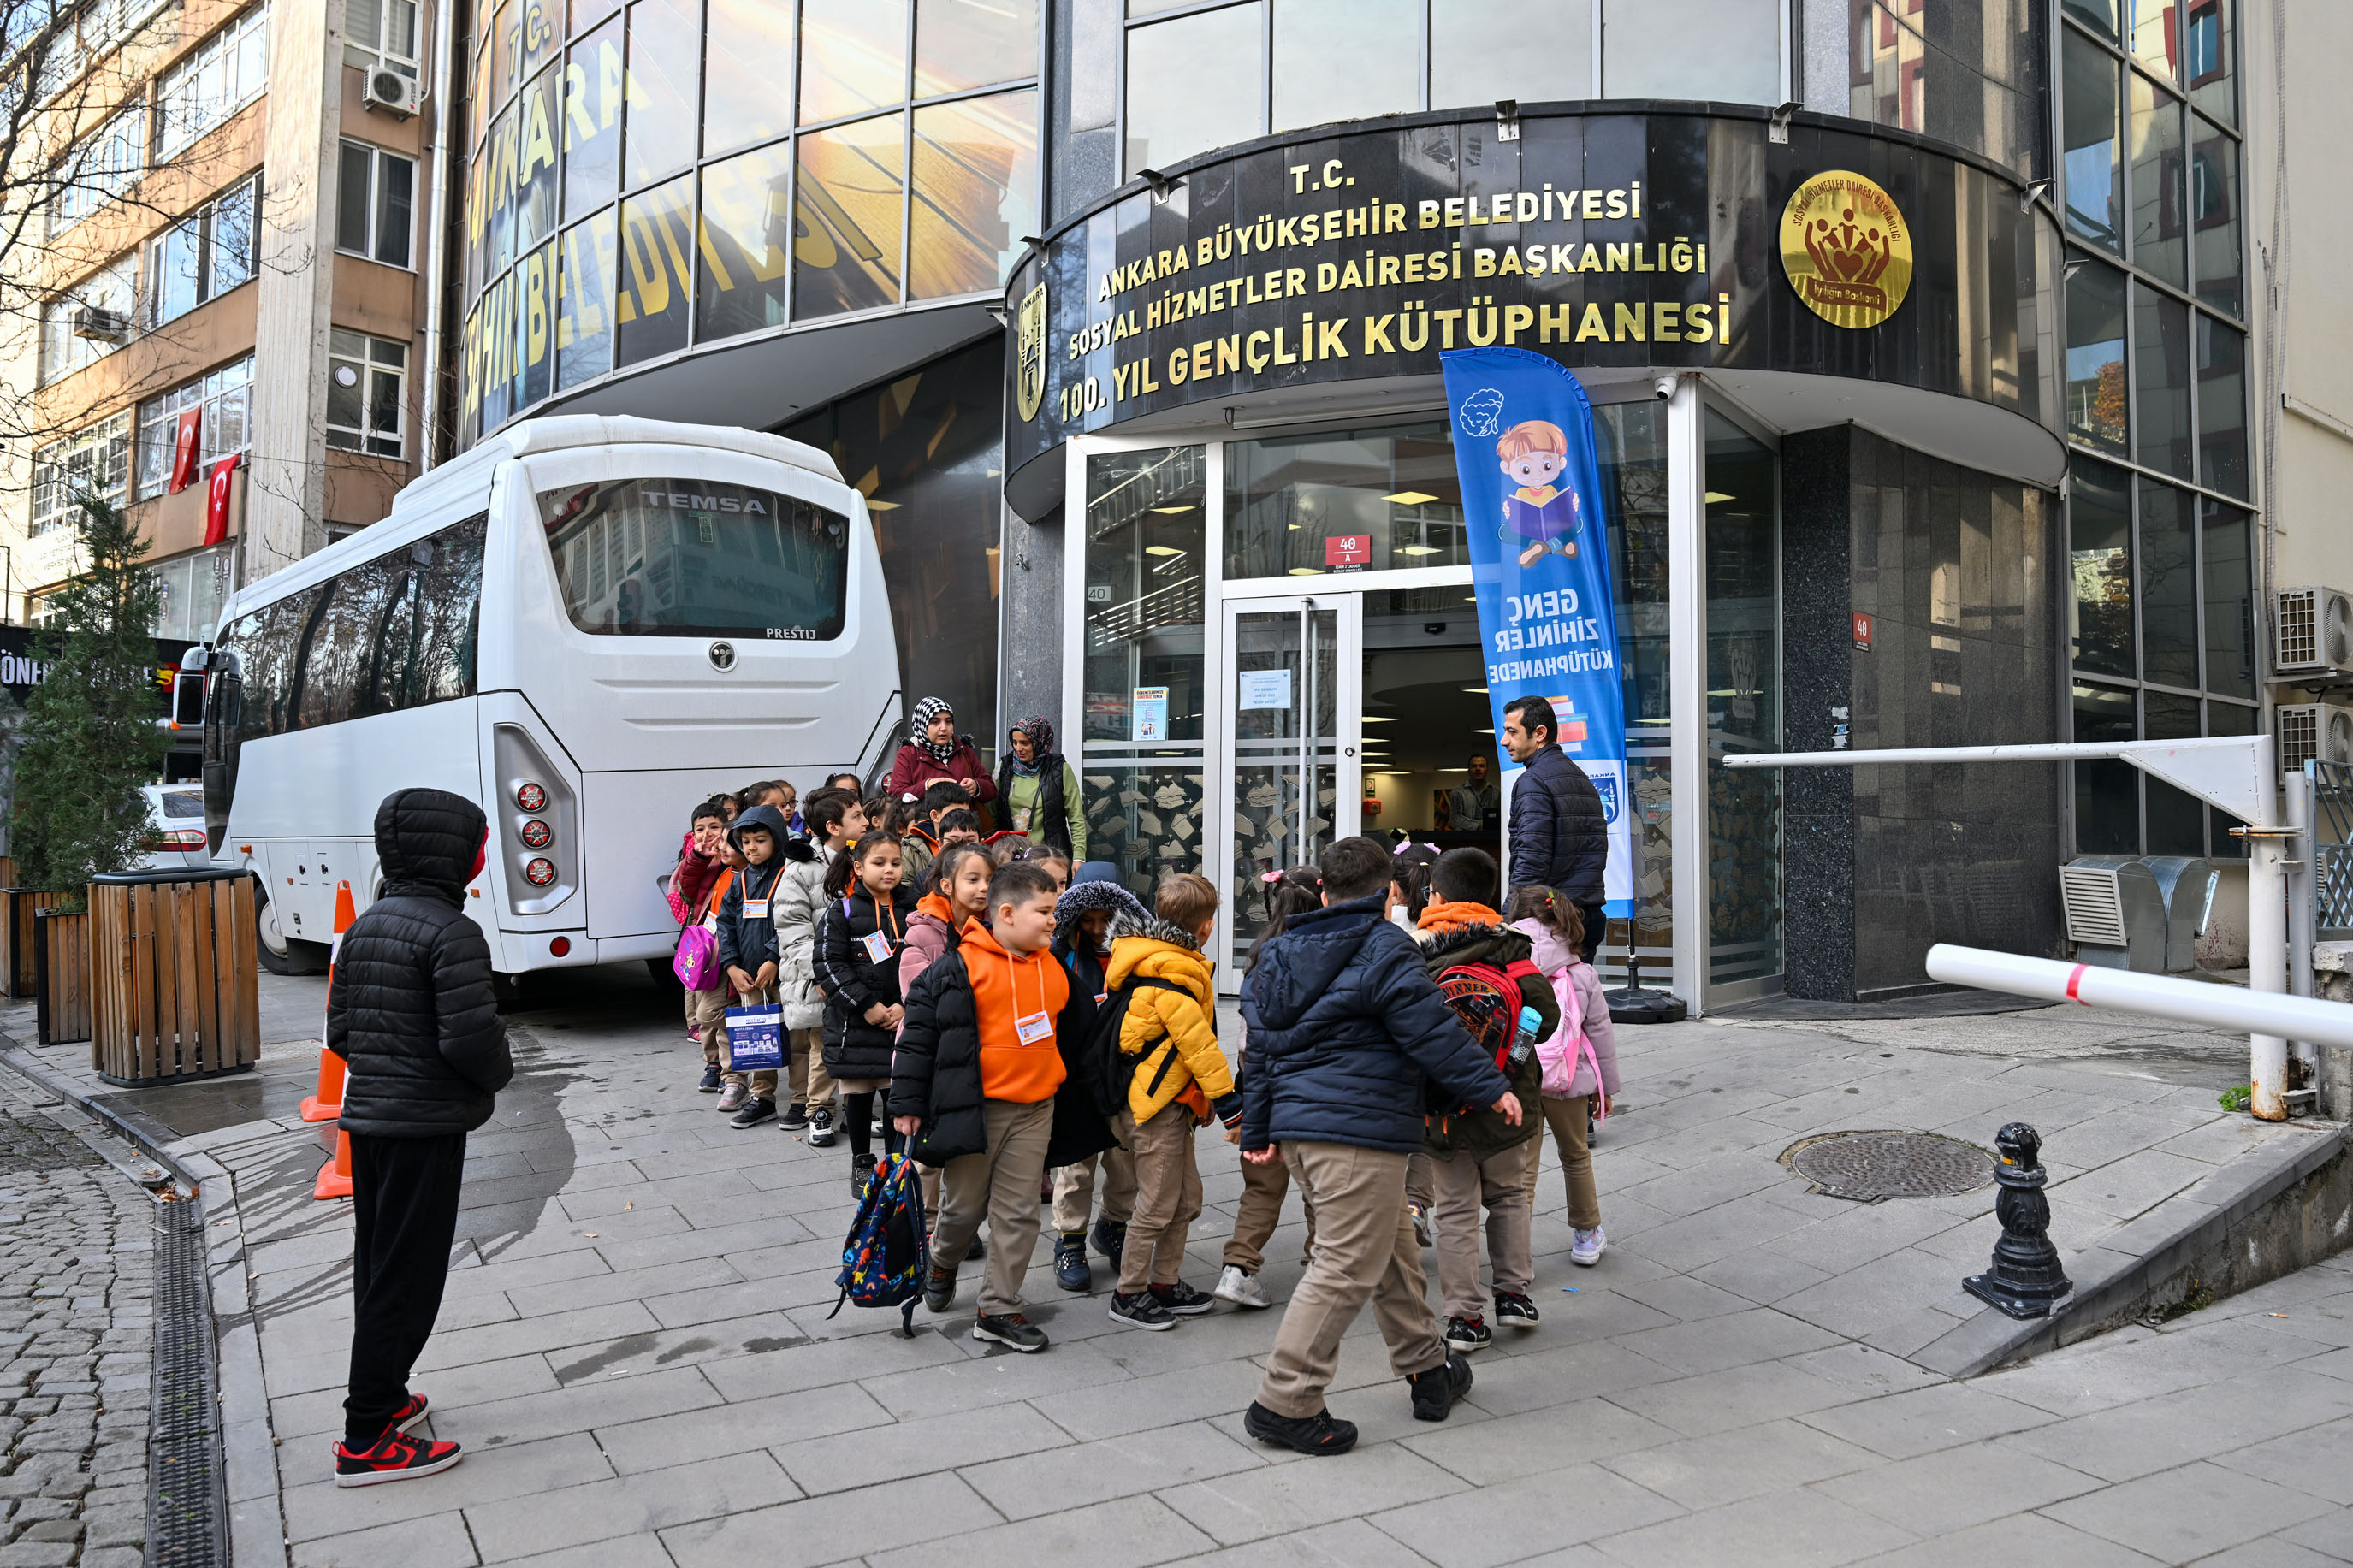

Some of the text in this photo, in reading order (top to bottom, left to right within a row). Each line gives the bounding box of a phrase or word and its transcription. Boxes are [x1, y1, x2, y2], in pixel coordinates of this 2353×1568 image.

[1289, 158, 1355, 195] T.C.
[1792, 179, 1900, 242] SOSYAL HİZMETLER DAİRESİ BAŞKANLIĞI
[1098, 180, 1641, 303] ANKARA BÜYÜKŞEHİR BELEDİYESİ
[1020, 287, 1044, 314] ANKARA
[1069, 236, 1707, 360] SOSYAL HİZMETLER DAİRESİ BAŞKANLIĞI
[1814, 281, 1881, 305] İyiliğin Başkenti
[1060, 293, 1730, 423] 100. YIL GENÇLİK KÜTÜPHANESİ
[642, 491, 768, 514] TEMSA
[1340, 538, 1356, 550] 40
[1088, 588, 1105, 600] 40
[766, 628, 816, 640] PRESTIJ
[1858, 619, 1867, 636] 40
